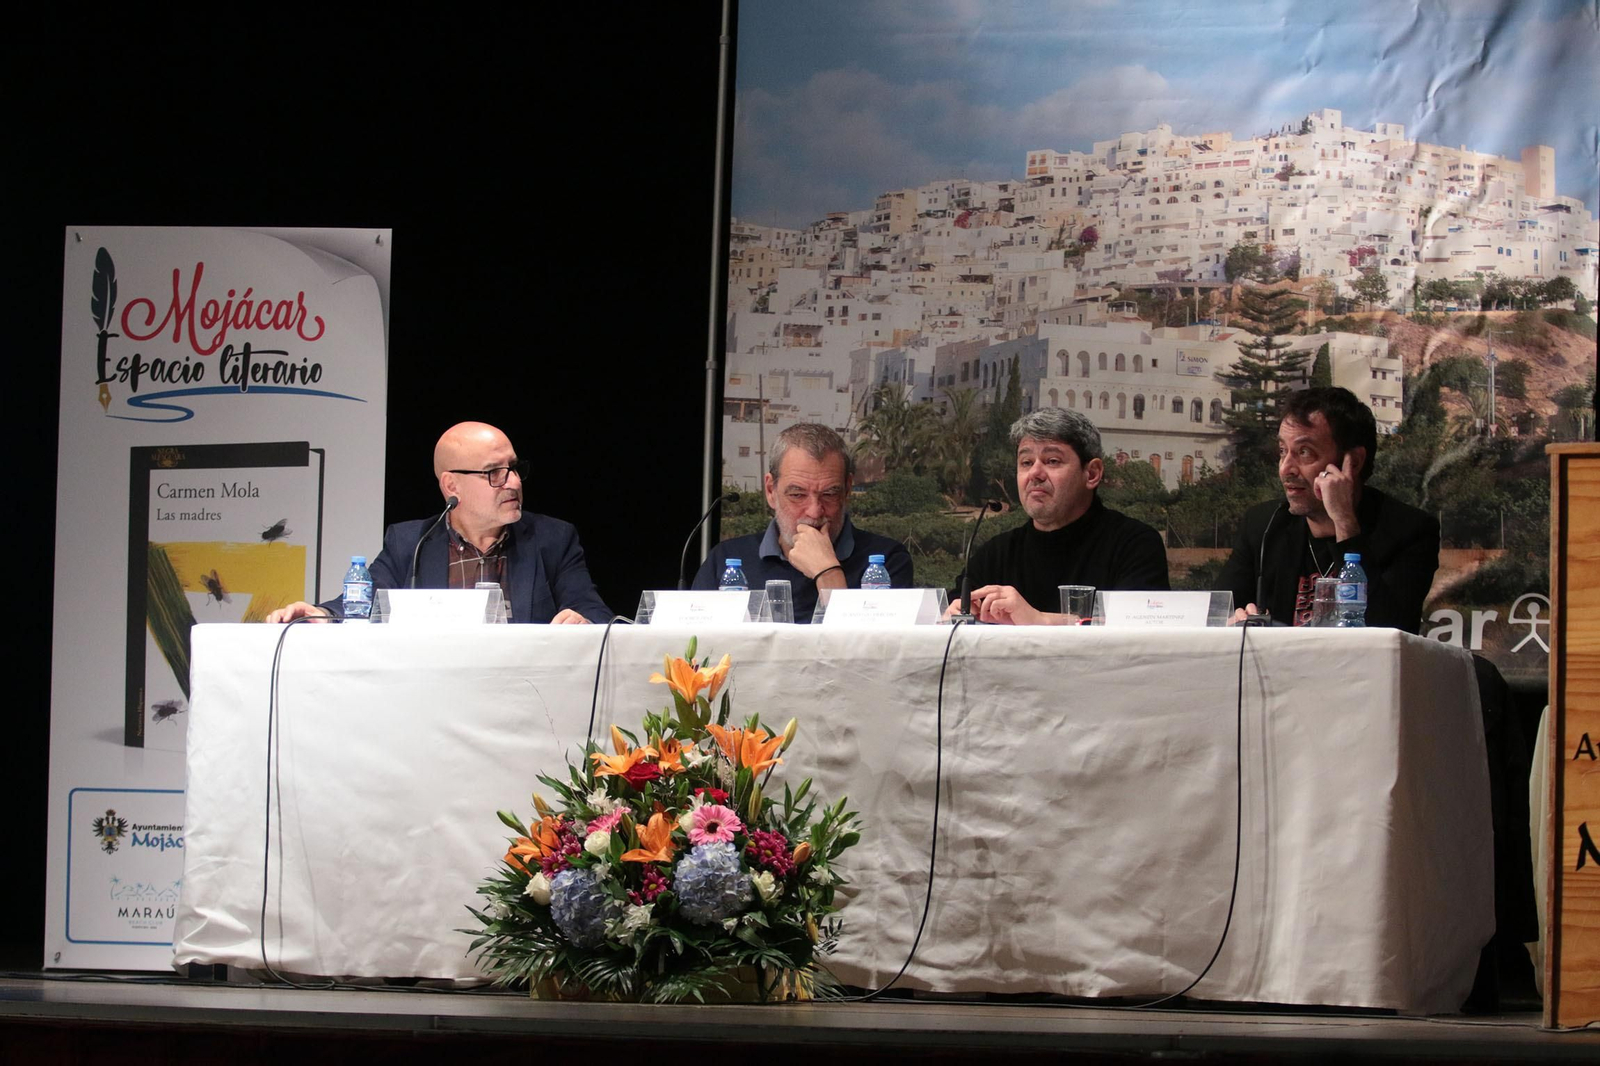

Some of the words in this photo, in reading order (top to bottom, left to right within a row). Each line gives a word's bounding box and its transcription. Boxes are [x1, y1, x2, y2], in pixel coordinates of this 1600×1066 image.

[121, 262, 325, 355] Mojácar
[95, 330, 204, 392] Espacio
[220, 342, 323, 392] literario
[157, 483, 215, 499] Carmen
[221, 481, 259, 499] Mola
[157, 508, 176, 521] Las
[180, 508, 222, 521] madres
[1421, 609, 1498, 650] ar
[118, 904, 174, 919] MARAÚ
